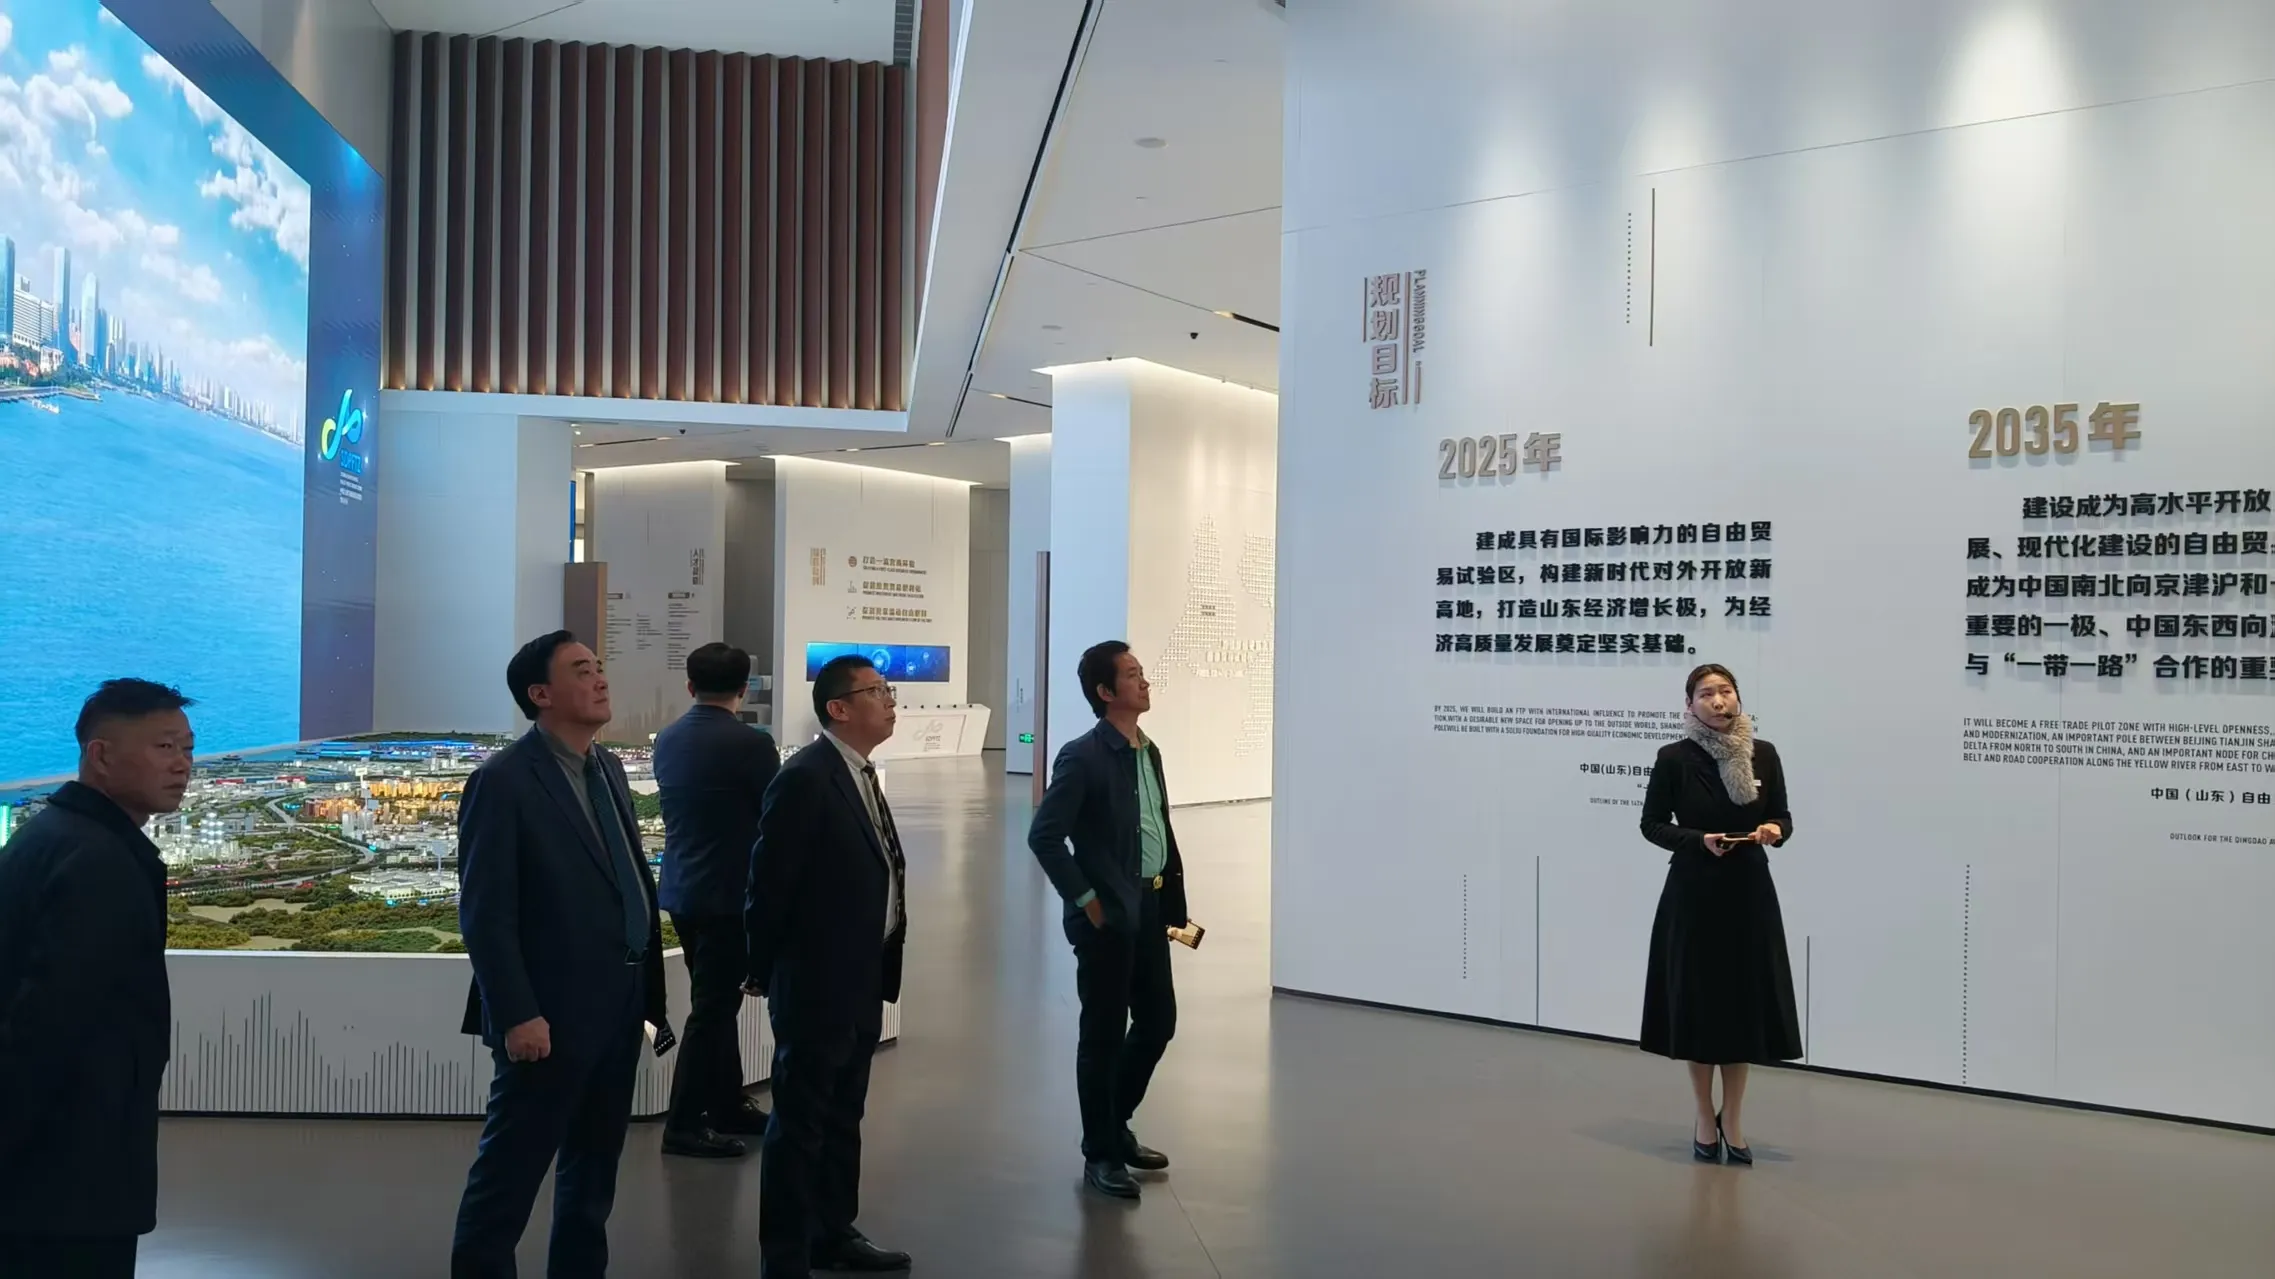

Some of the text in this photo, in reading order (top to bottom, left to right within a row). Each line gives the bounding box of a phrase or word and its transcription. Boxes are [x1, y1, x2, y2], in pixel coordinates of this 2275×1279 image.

[1369, 273, 1400, 409] 规划目标
[2022, 489, 2271, 519] 建设成为高水平开放
[1476, 521, 1772, 550] 建成具有国际影响力的自由贸
[1966, 531, 2275, 559] 展、现代化建设的自由贸
[1436, 558, 1772, 585] 易试验区，构建新时代对外开放新
[1966, 573, 2275, 598] 成为中国南北向京津沪和
[1436, 596, 1772, 619] 高地，打造山东经济增长极，为经
[1965, 613, 2275, 638] 重要的一极、中国东西向
[1435, 633, 1696, 655] 济高质量发展奠定坚实基础。
[1965, 653, 2275, 680] 与“一带一路”合作的重
[1460, 706, 1468, 714] WE
[1471, 706, 1485, 714] WILL
[1487, 707, 1503, 715] BUILD
[1505, 707, 1513, 715] AN
[1529, 708, 1543, 716] WITH
[1546, 708, 1590, 717] INTERNATIONAL
[1593, 710, 1624, 718] INFLUENCE
[1638, 711, 1666, 719] PROMOTE
[1470, 716, 1498, 724] DESIRABLE
[1486, 726, 1499, 734] WITH
[1523, 728, 1558, 736] FOUNDATION
[1612, 731, 1642, 739] ECONOMIC
[1964, 718, 1971, 726] IT
[1974, 718, 1993, 727] WILL
[1996, 719, 2028, 728] BECOME
[2031, 720, 2036, 728] A
[2040, 720, 2059, 728] FREE
[2063, 721, 2088, 729] TRADE
[2092, 721, 2116, 730] PILOT
[2118, 722, 2140, 731] ZONE
[2143, 722, 2166, 732] WITH
[2169, 723, 2219, 733] HIGH-LEVEL
[1964, 730, 1980, 739] AND
[1982, 731, 2049, 741] MODERNIZATION,
[2052, 732, 2063, 741] AN
[2066, 733, 2114, 743] IMPORTANT
[2116, 734, 2137, 743] POLE
[2140, 735, 2180, 745] BETWEEN
[2183, 736, 2217, 746] BEIJING
[2220, 737, 2255, 747] TIANJIN
[1964, 742, 1988, 751] DELTA
[1990, 742, 2012, 751] FROM
[2014, 743, 2041, 752] NORTH
[2044, 744, 2053, 753] TO
[2056, 744, 2083, 754] SOUTH
[2086, 745, 2094, 754] IN
[2096, 746, 2125, 755] CHINA,
[2128, 747, 2146, 756] AND
[2148, 747, 2160, 756] AN
[2162, 748, 2213, 758] IMPORTANT
[2216, 749, 2239, 759] NODE
[2242, 750, 2259, 760] FOR
[1964, 753, 1982, 761] BELT
[1984, 754, 2000, 762] AND
[2003, 754, 2025, 763] ROAD
[2027, 755, 2084, 765] COOPERATION
[2086, 757, 2114, 766] ALONG
[2117, 758, 2132, 767] THE
[2135, 759, 2168, 769] YELLOW
[2171, 760, 2196, 770] RIVER
[2200, 761, 2223, 771] FROM
[2227, 762, 2248, 772] EAST
[2252, 763, 2262, 772] TO
[2170, 833, 2201, 841] OUTLOOK
[2203, 834, 2217, 842] FOR
[2220, 835, 2232, 843] THE
[2235, 836, 2267, 845] QINGDAO
